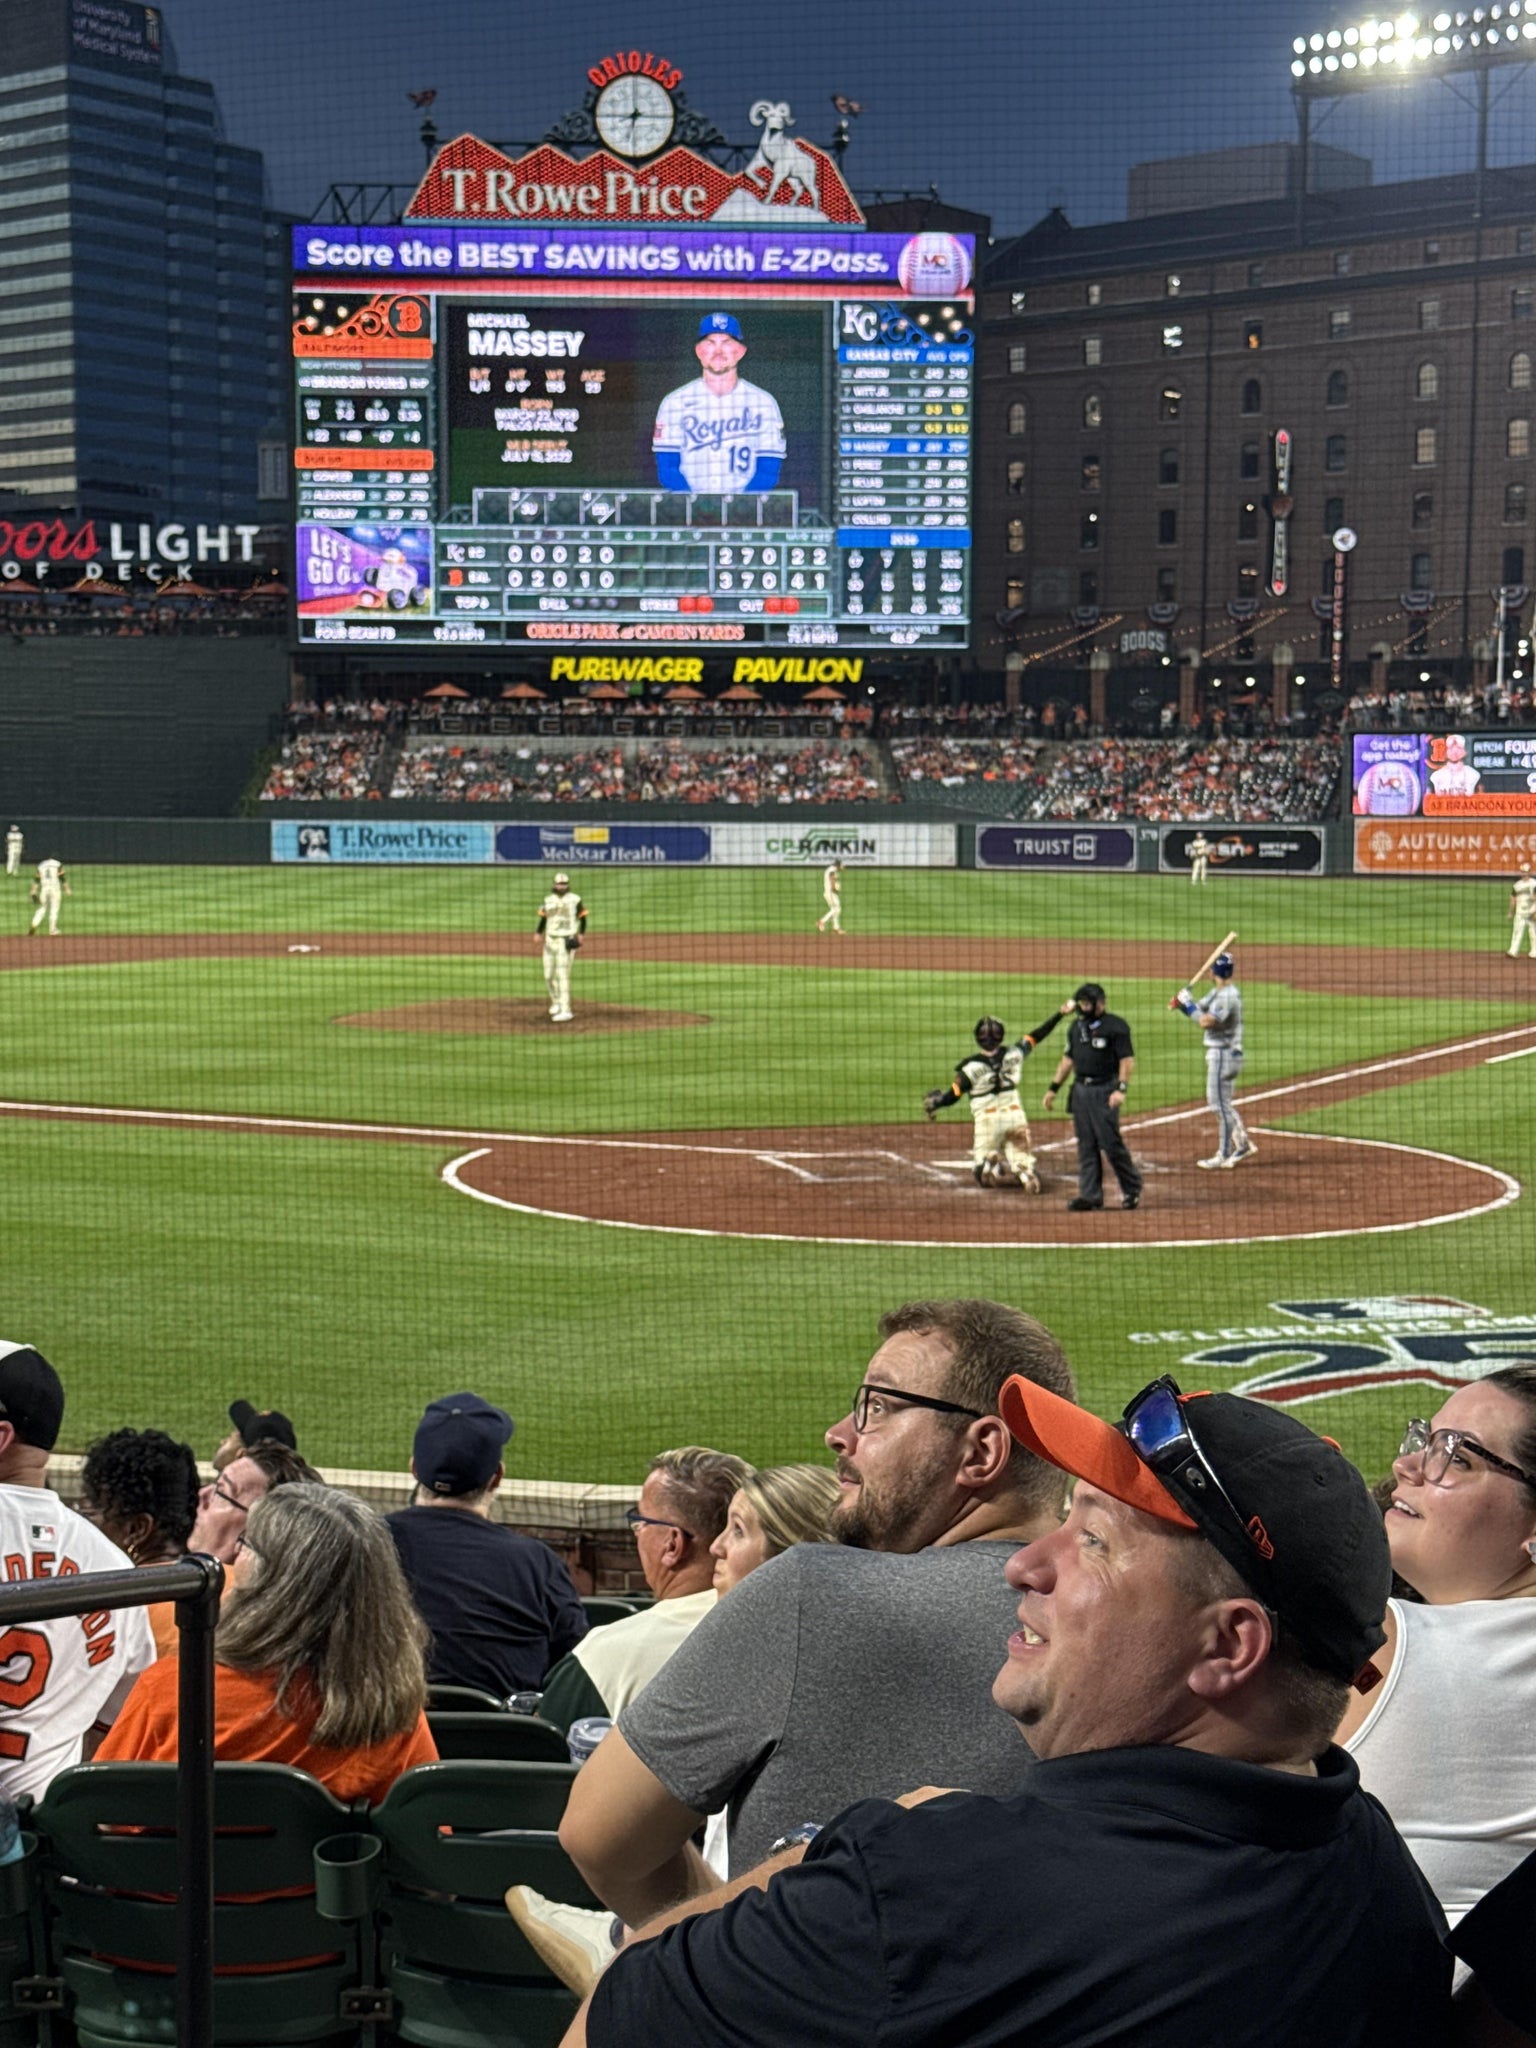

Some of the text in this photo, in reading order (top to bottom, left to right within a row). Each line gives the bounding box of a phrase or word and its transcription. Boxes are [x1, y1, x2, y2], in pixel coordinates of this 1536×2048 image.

[588, 50, 684, 90] ORIOLES
[307, 238, 394, 267] Score
[399, 239, 453, 268] the
[457, 241, 540, 269] BEST
[544, 243, 680, 272] SAVINGS
[685, 243, 755, 272] with
[761, 245, 890, 274] E-ZPass.
[467, 312, 530, 329] MICHAEL
[842, 304, 878, 341] KC
[468, 329, 586, 358] MASSEY
[681, 407, 762, 450] Royals
[728, 445, 751, 473] 19
[110, 522, 261, 562] LIGHT
[508, 545, 523, 563] 0
[530, 545, 546, 563] 0
[552, 545, 568, 564] 0
[578, 545, 592, 564] 2
[599, 546, 615, 564] 0
[719, 547, 733, 566] 2
[740, 547, 755, 566] 7
[762, 547, 777, 566] 0
[791, 548, 805, 566] 2
[812, 548, 827, 566] 2
[85, 560, 193, 581] DECK
[508, 570, 523, 588] 0
[531, 570, 545, 588] 2
[552, 570, 568, 588] 0
[579, 570, 591, 588] 1
[599, 570, 615, 588] 0
[719, 571, 733, 590] 3
[740, 571, 755, 590] 7
[762, 571, 777, 590] 0
[790, 572, 805, 590] 4
[814, 572, 825, 590] 1
[697, 624, 745, 641] YARDS
[550, 656, 865, 684] PUREWAGER PAVILION
[1391, 738, 1411, 751] the
[1446, 800, 1506, 812] BRANDON
[1013, 838, 1071, 856] TRUIST
[1398, 832, 1536, 851] AUTUMN LAKE
[542, 845, 666, 861] MedStar Health
[1127, 1318, 1452, 1345] CELEBRATING
